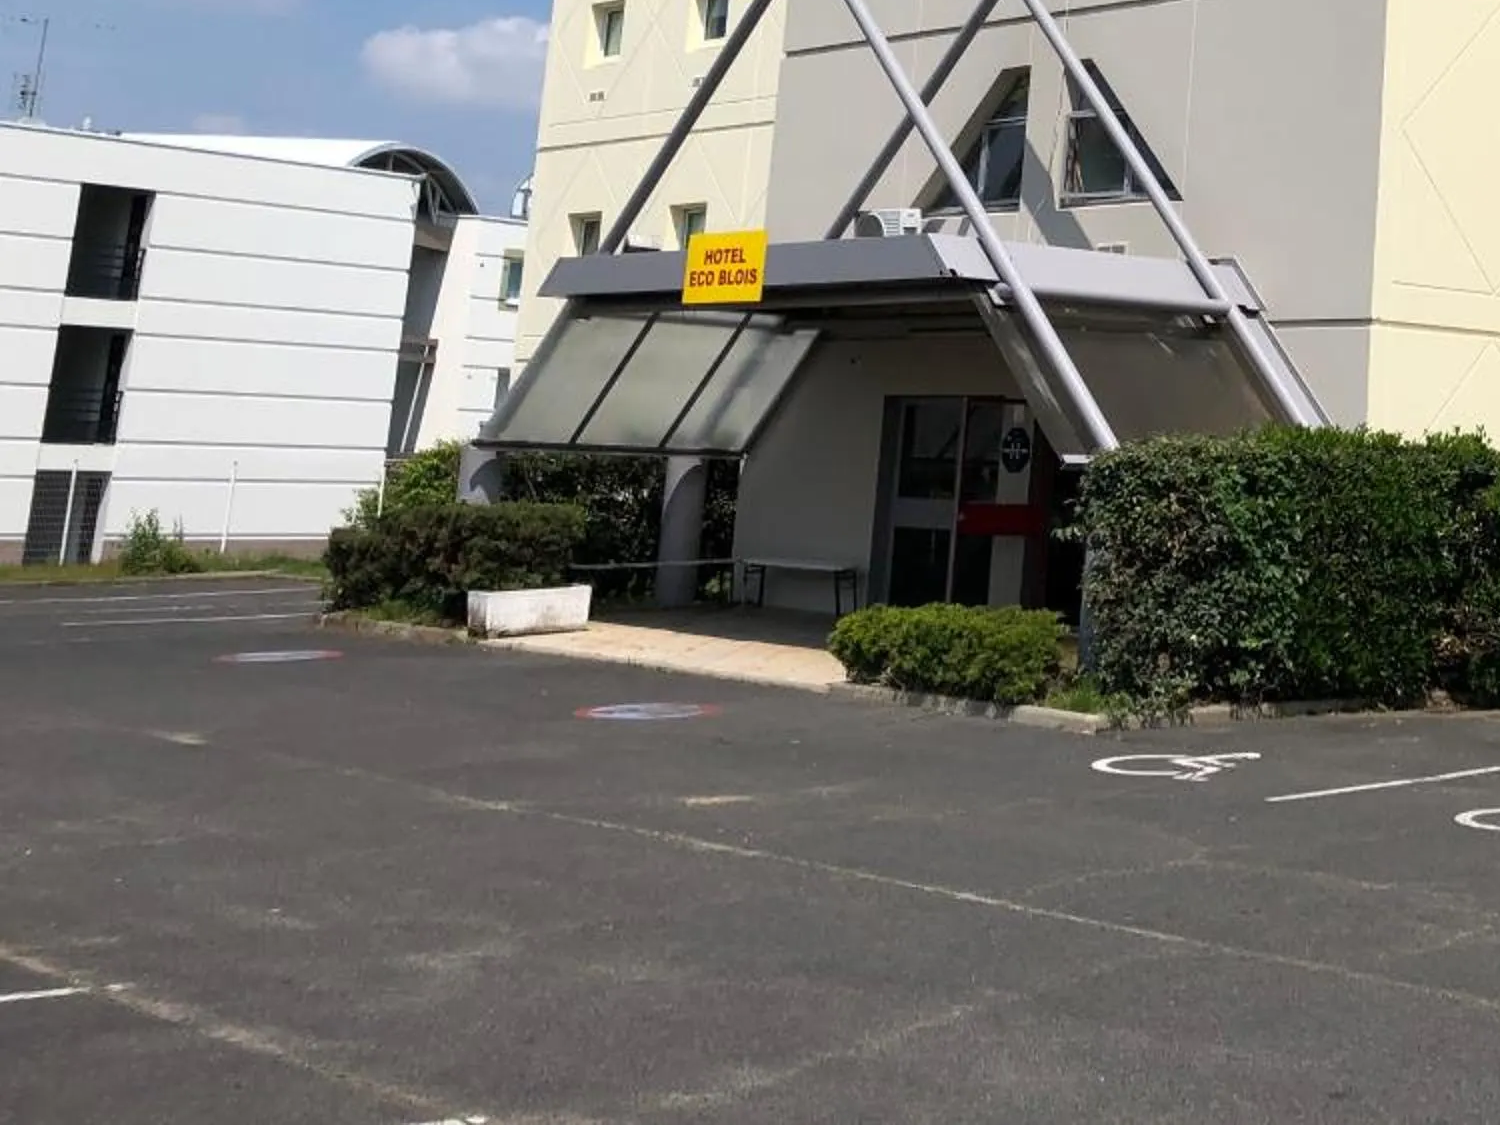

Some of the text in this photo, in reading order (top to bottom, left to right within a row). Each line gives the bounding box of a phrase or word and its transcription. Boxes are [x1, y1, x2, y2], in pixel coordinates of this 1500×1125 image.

[703, 246, 747, 265] HOTEL
[689, 268, 758, 287] ECO BLOIS
